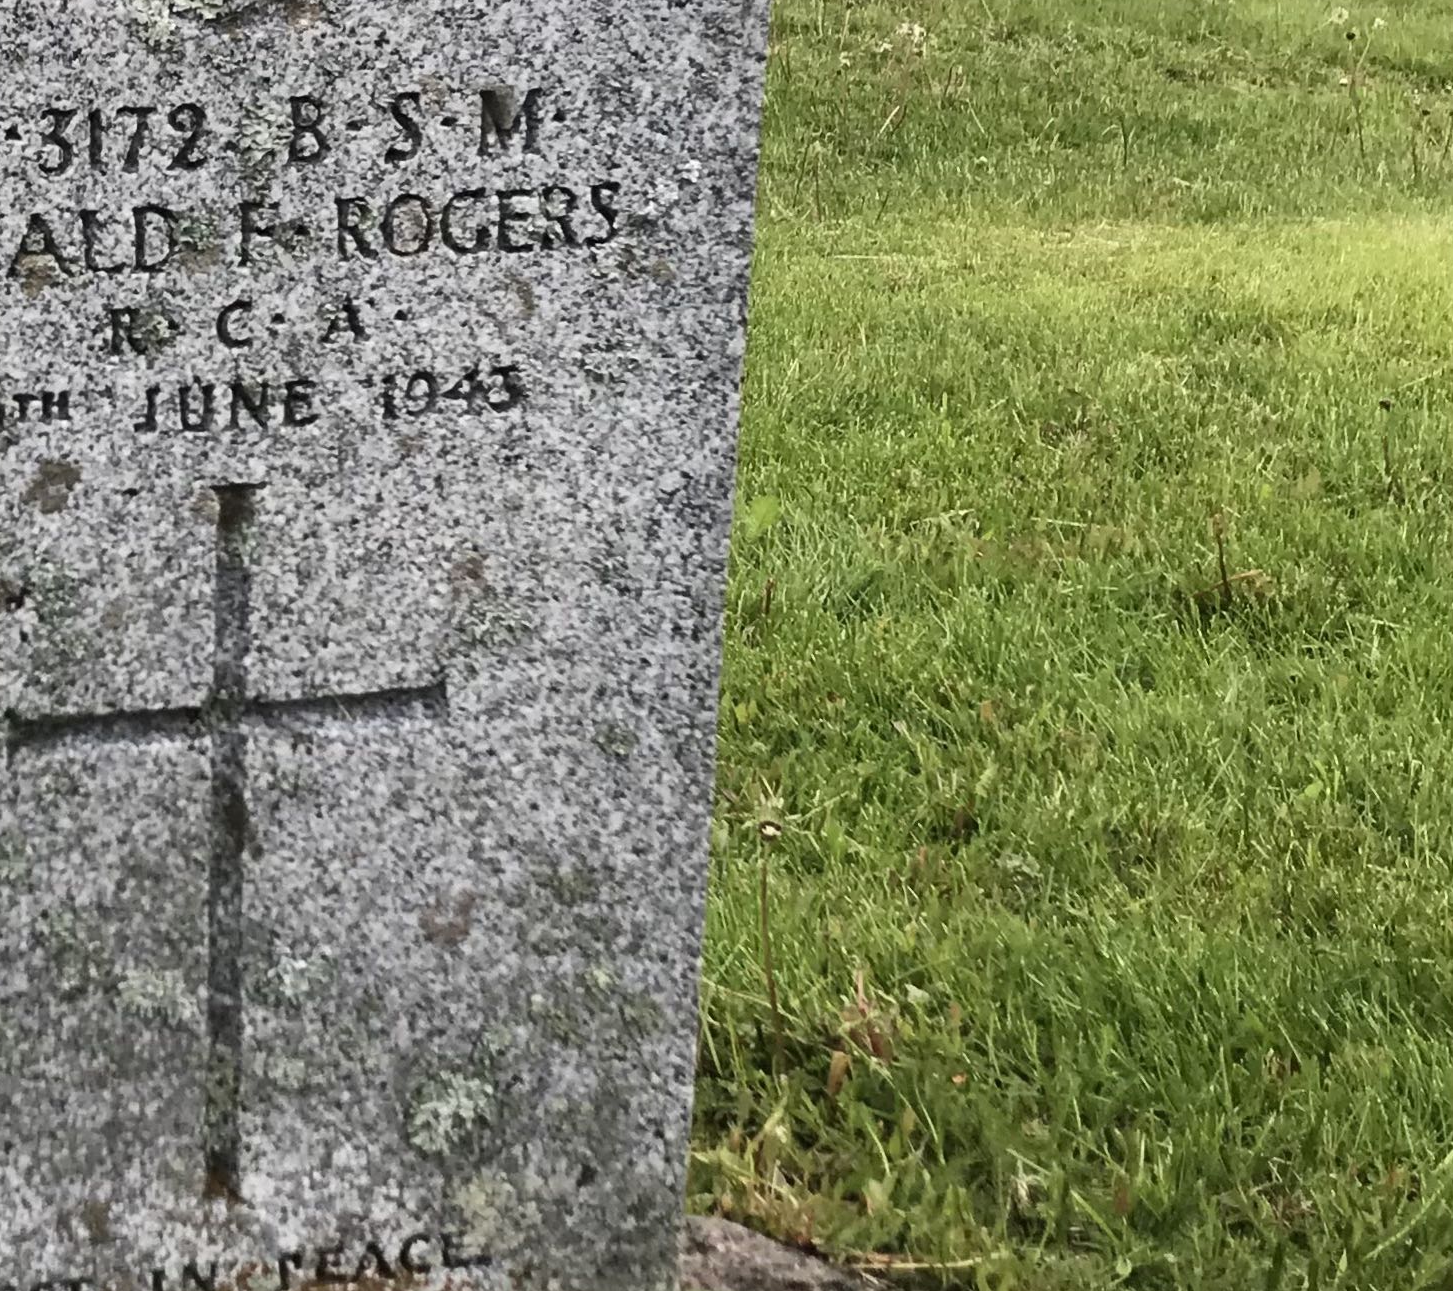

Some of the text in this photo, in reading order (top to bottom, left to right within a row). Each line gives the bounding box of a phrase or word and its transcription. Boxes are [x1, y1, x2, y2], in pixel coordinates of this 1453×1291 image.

[334, 181, 622, 259] ROGERS
[133, 376, 318, 433] JUNE
[278, 1230, 494, 1291] PEACE
